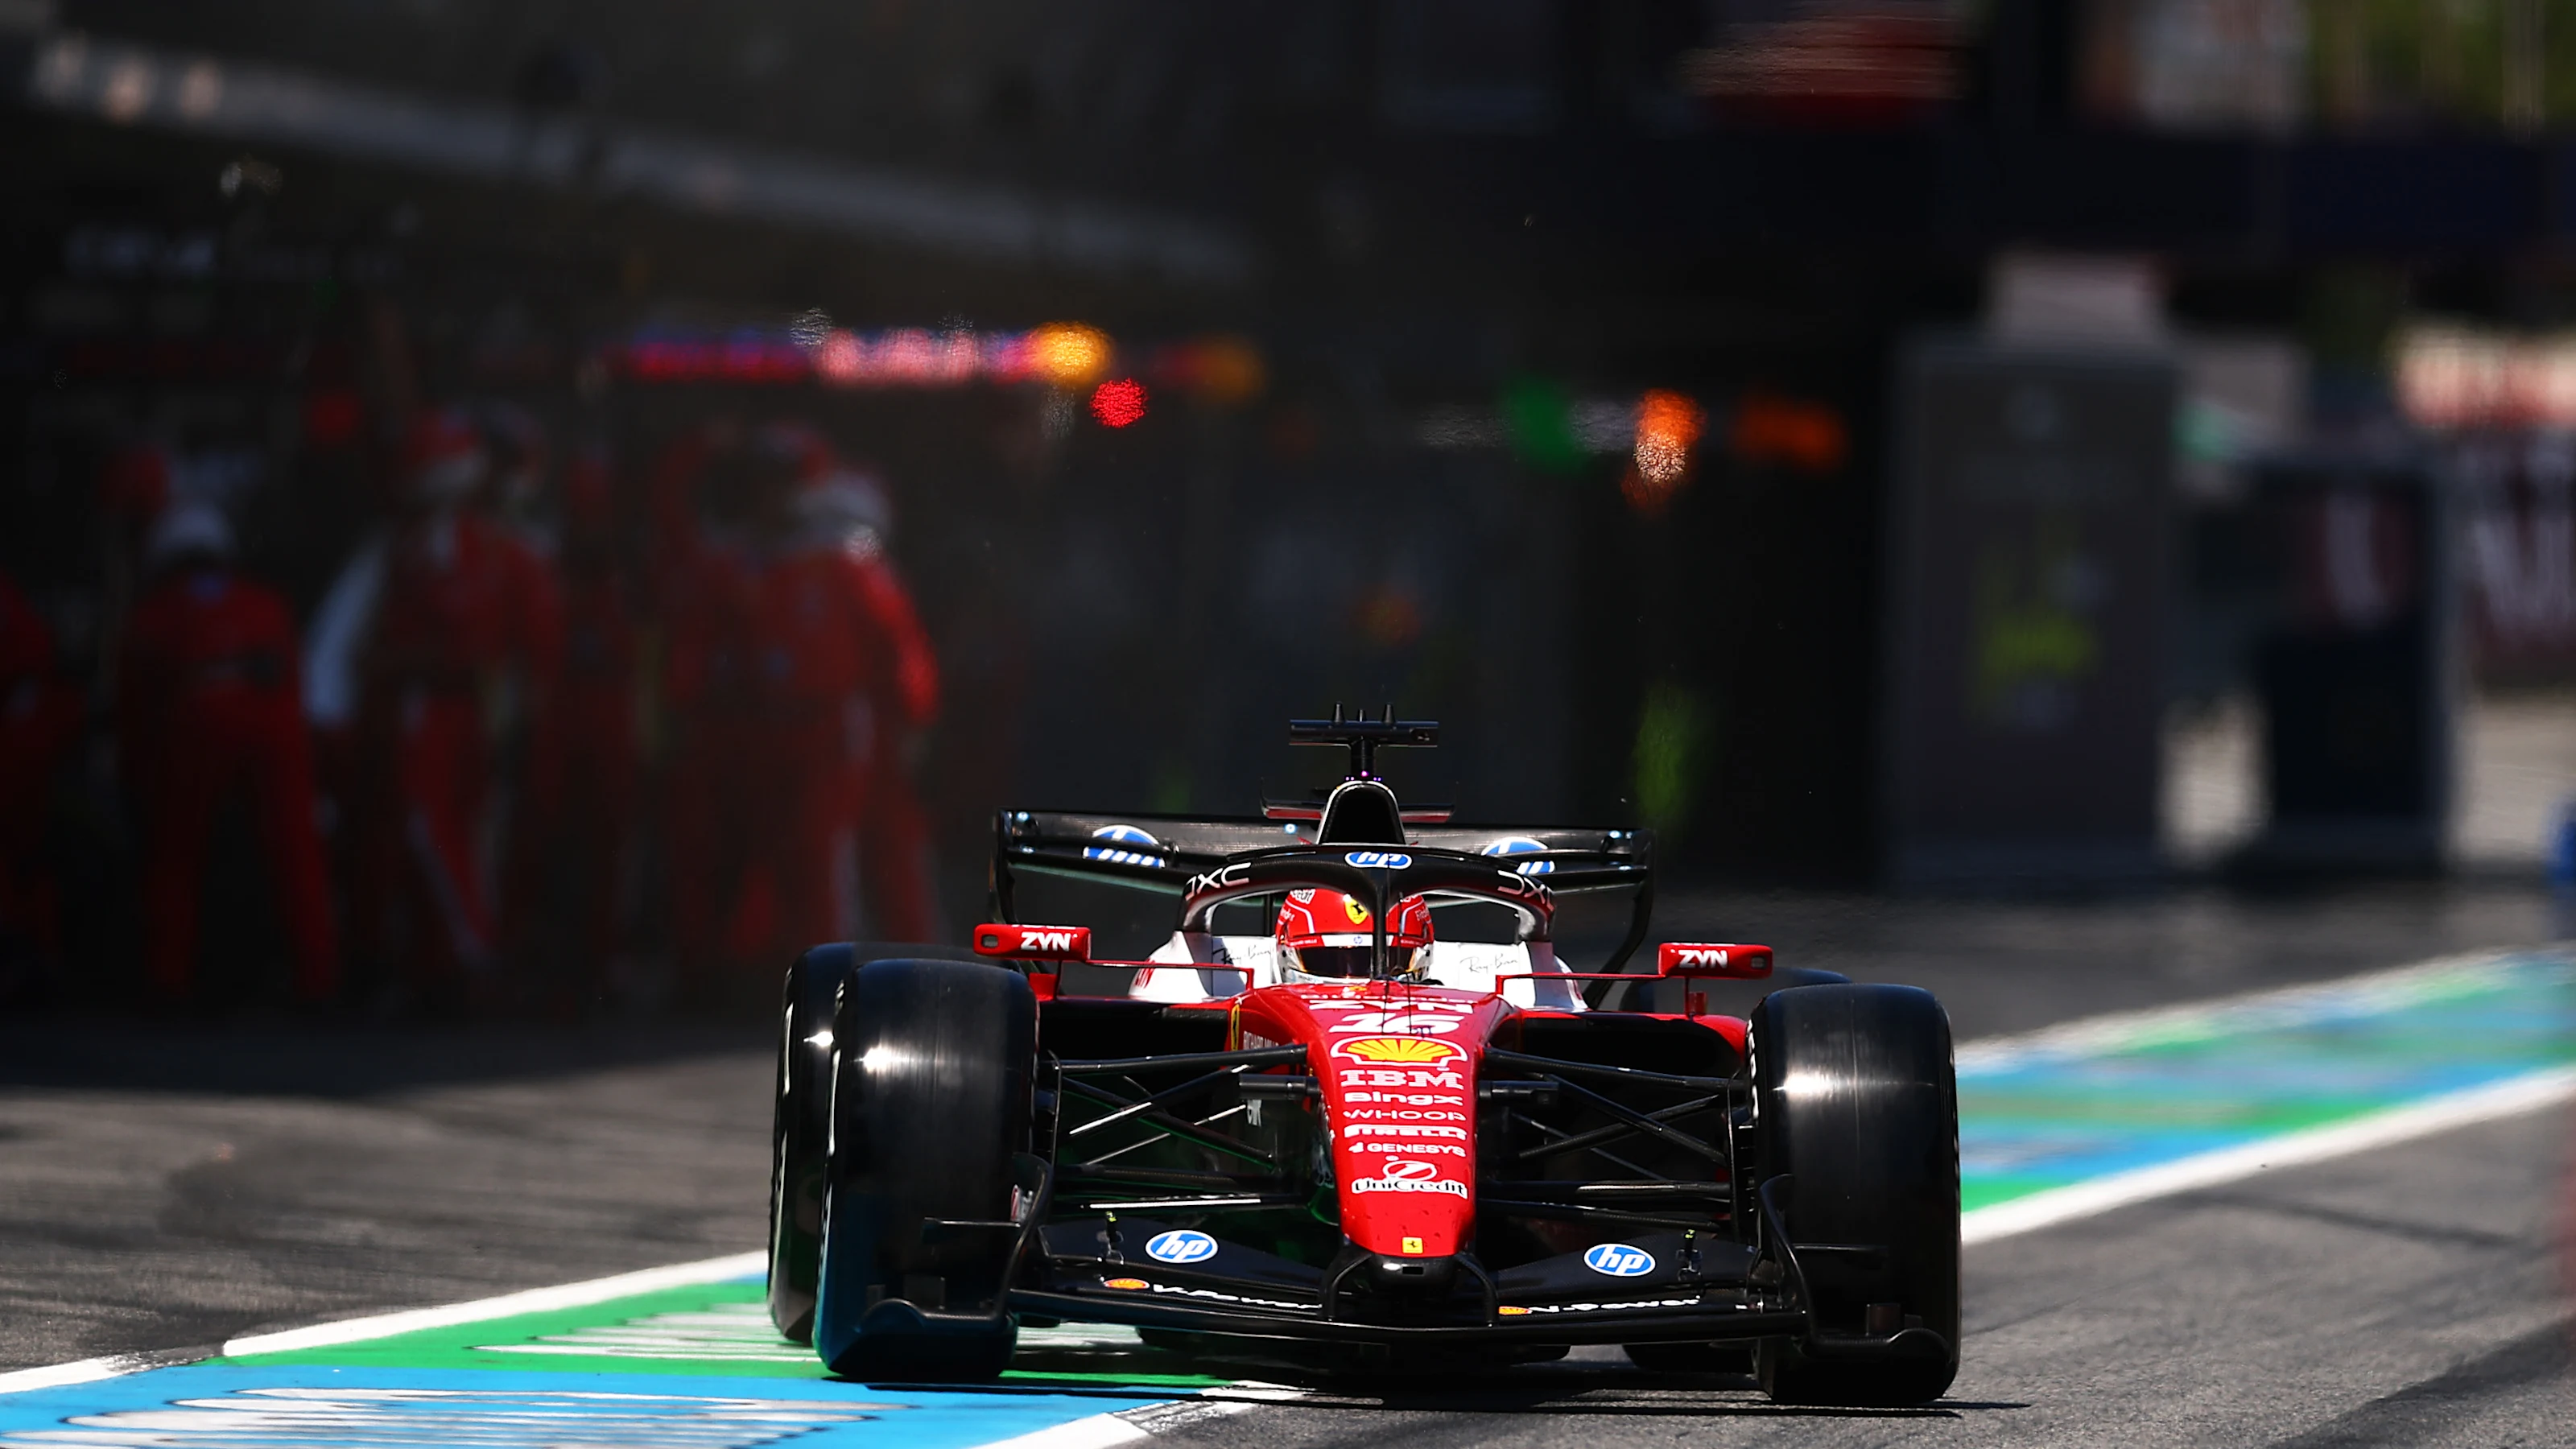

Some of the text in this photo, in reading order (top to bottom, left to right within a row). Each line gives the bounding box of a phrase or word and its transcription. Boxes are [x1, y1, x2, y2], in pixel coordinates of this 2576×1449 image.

[1355, 852, 1403, 868] hp
[1021, 932, 1071, 952] ZYN
[1459, 953, 1518, 974] Ray-Ban
[1678, 949, 1728, 968] ZYN
[1309, 1000, 1473, 1013] ZYN
[1329, 1013, 1464, 1034] 16
[1340, 1070, 1464, 1089] IBM
[1343, 1109, 1467, 1121] WHOOP
[1344, 1124, 1468, 1140] PIRELLI
[1367, 1142, 1467, 1157] GENESYS
[1354, 1179, 1466, 1197] UniCredit
[1154, 1231, 1210, 1262] hp
[1595, 1245, 1647, 1274] hp
